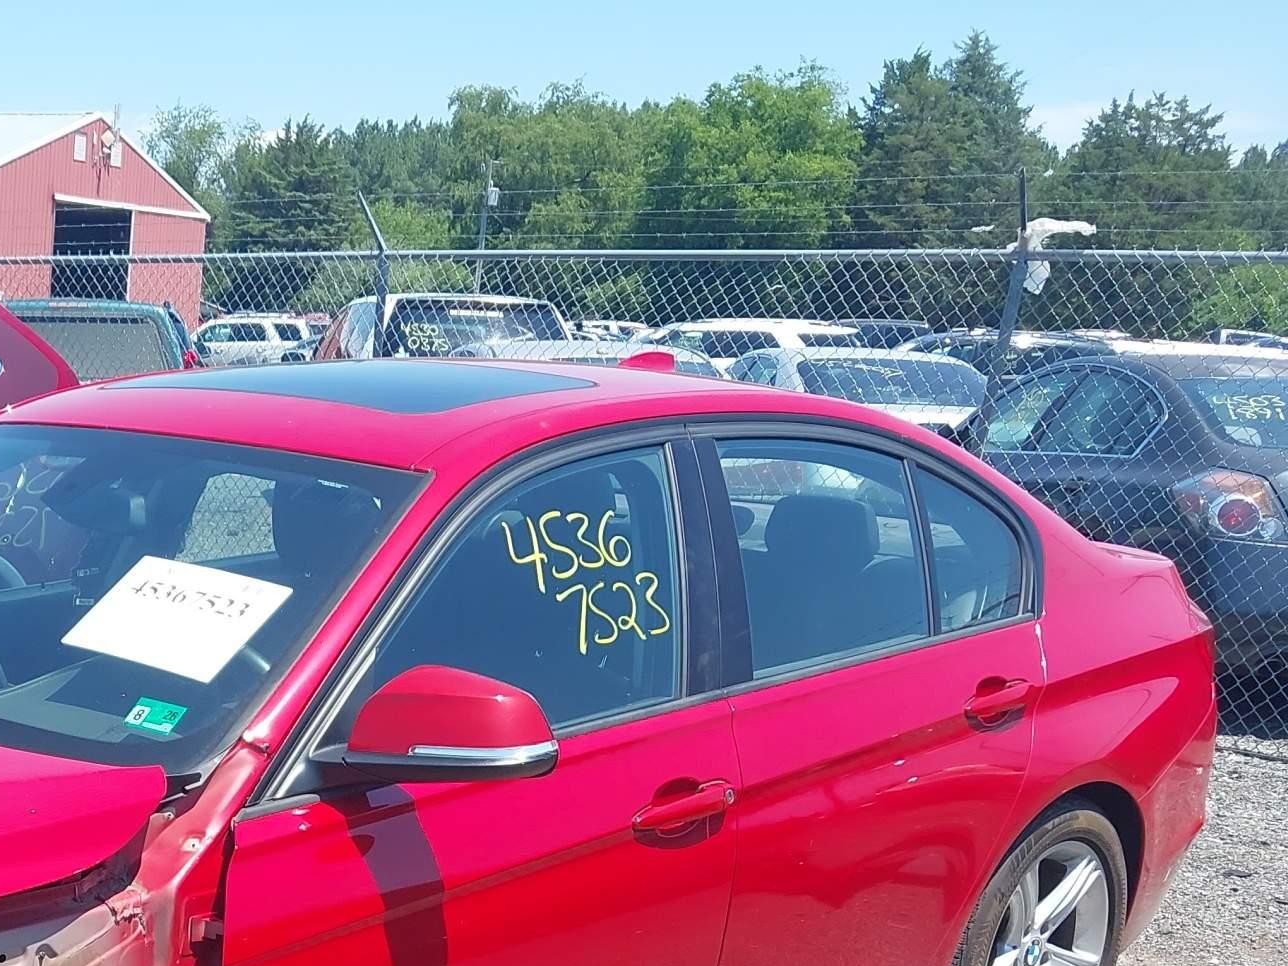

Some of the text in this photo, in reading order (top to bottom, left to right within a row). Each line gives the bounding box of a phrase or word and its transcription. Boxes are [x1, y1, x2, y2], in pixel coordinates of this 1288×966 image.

[501, 510, 632, 594] 4536
[132, 579, 251, 618] 45367523
[555, 571, 670, 655] 7523
[133, 709, 146, 721] 8
